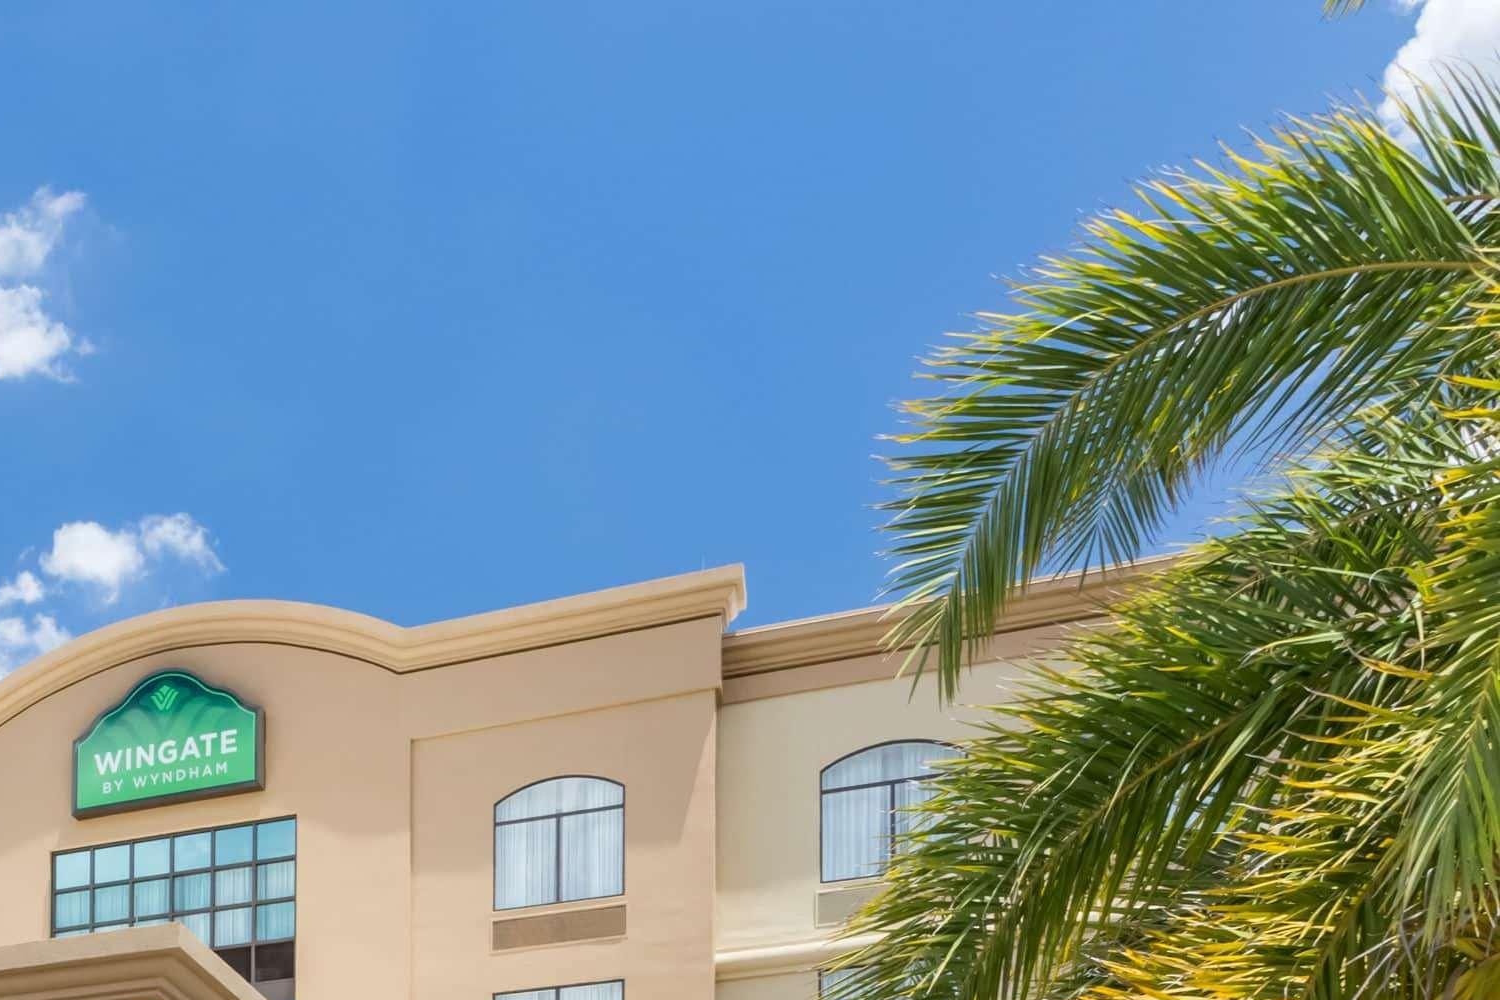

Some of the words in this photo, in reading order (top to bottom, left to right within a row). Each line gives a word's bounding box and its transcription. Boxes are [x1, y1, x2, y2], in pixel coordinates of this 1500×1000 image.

[94, 729, 238, 775] WINGATE
[102, 779, 124, 794] BY
[132, 761, 228, 788] WYNDHAM
